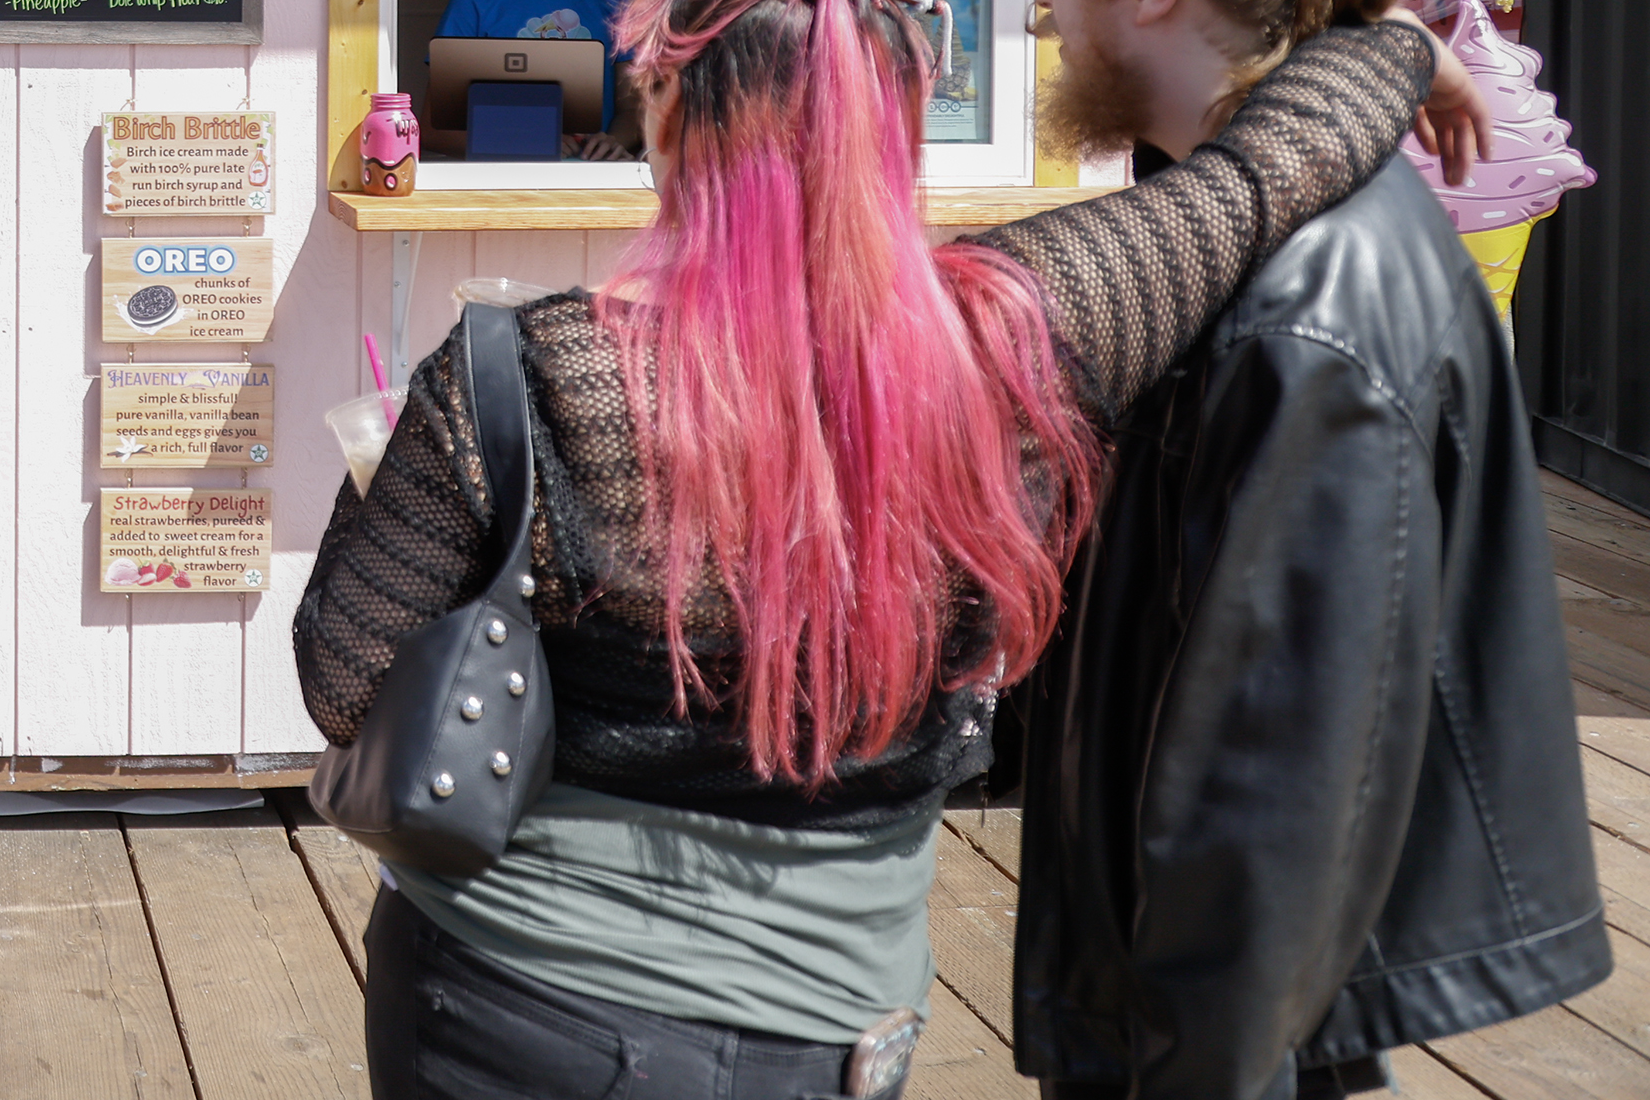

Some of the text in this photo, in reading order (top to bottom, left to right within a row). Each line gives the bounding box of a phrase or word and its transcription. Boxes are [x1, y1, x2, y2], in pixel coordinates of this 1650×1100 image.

[113, 116, 261, 140] Birch Brittle
[127, 147, 157, 157] Birch
[159, 147, 175, 156] ice
[216, 146, 248, 156] made
[130, 163, 245, 175] with 100% pure late
[137, 248, 234, 273] OREO
[183, 294, 262, 304] OREO cookies
[108, 369, 270, 388] HEAVENLY VANILLA
[116, 409, 259, 422] pure vanilla, vanilla bean
[113, 496, 265, 518] Strawberry Delight
[184, 561, 246, 572] strawberry
[203, 576, 237, 586] flavor
